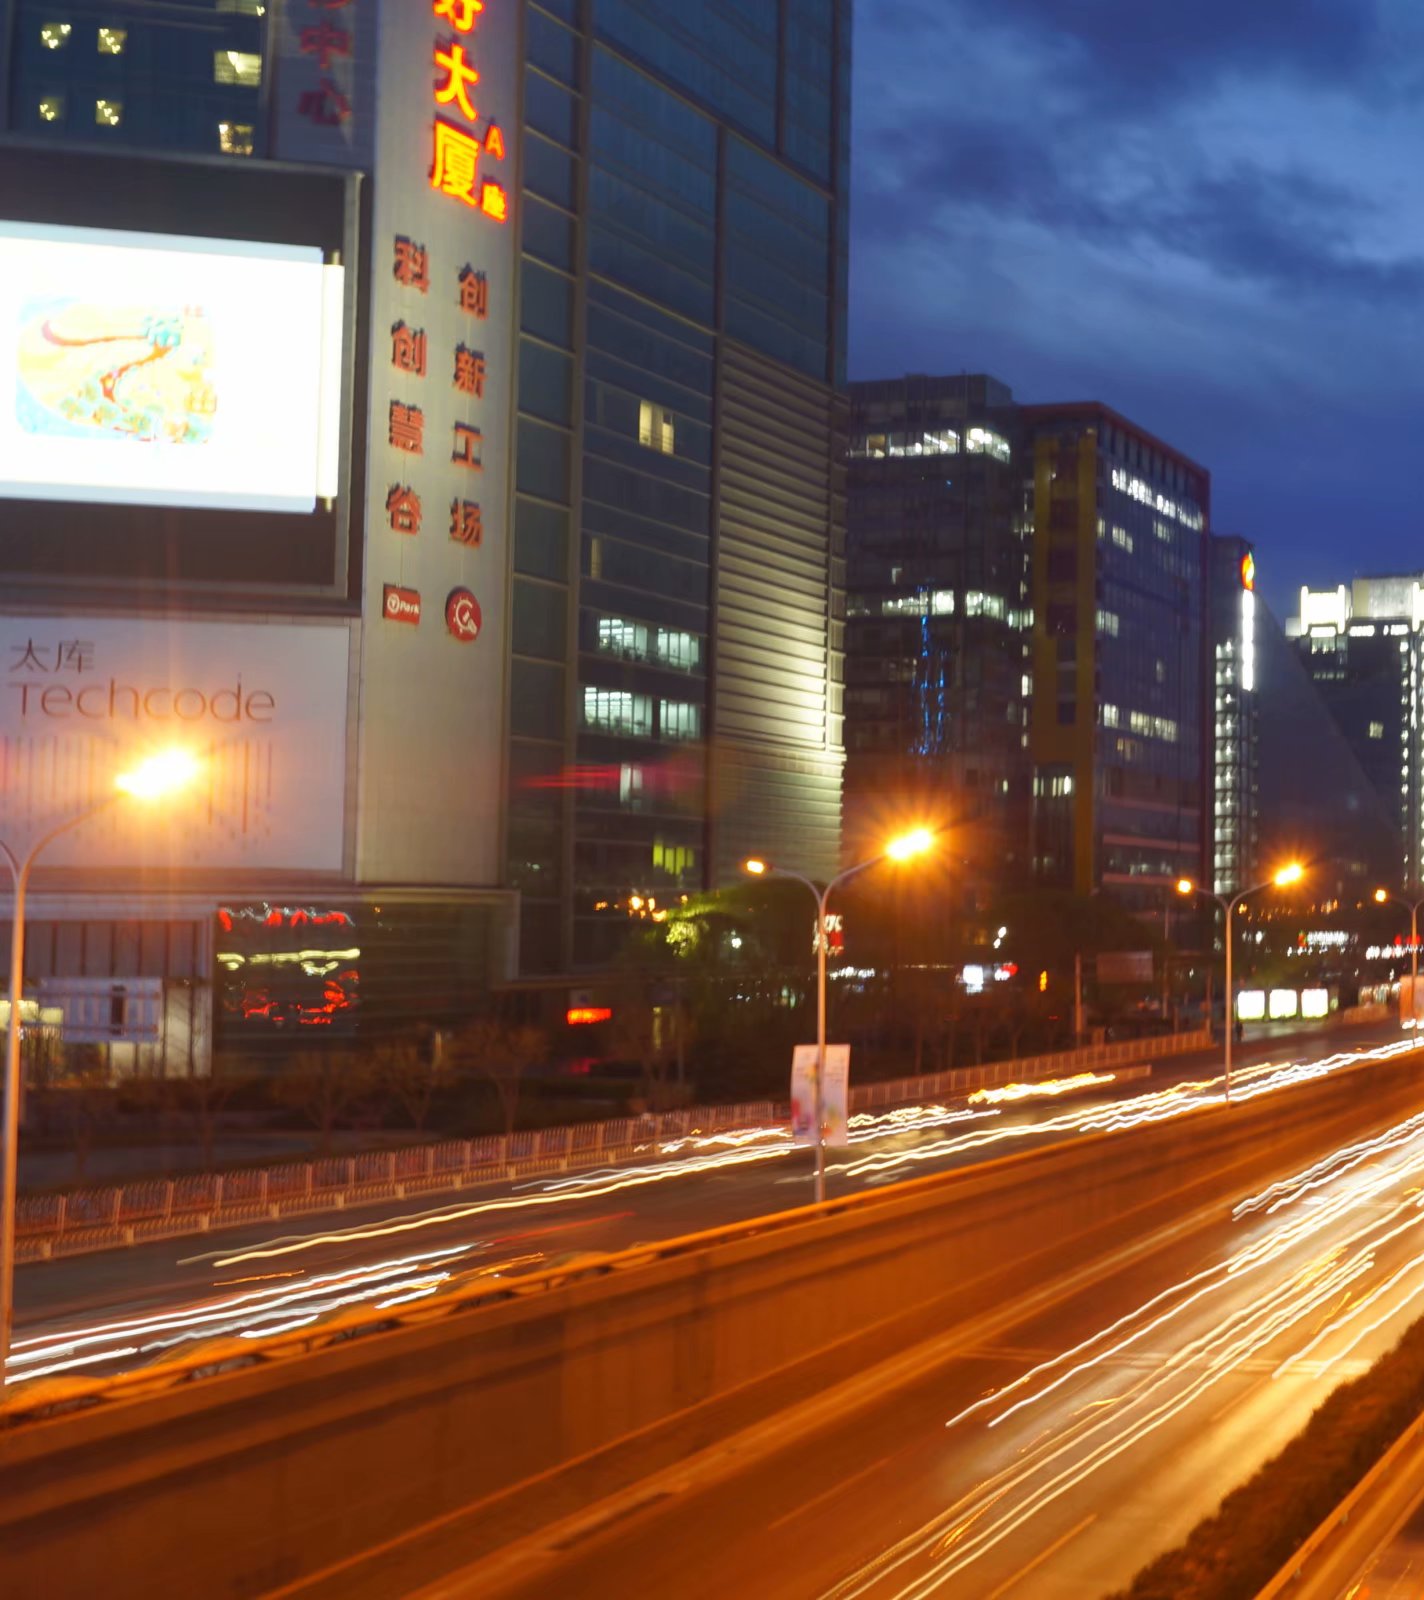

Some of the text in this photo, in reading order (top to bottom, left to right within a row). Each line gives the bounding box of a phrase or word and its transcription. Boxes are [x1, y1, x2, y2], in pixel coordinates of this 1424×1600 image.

[298, 0, 352, 125] 中心
[450, 263, 489, 548] 创新工场
[7, 672, 275, 723] Techcode
[8, 637, 95, 674] 太库
